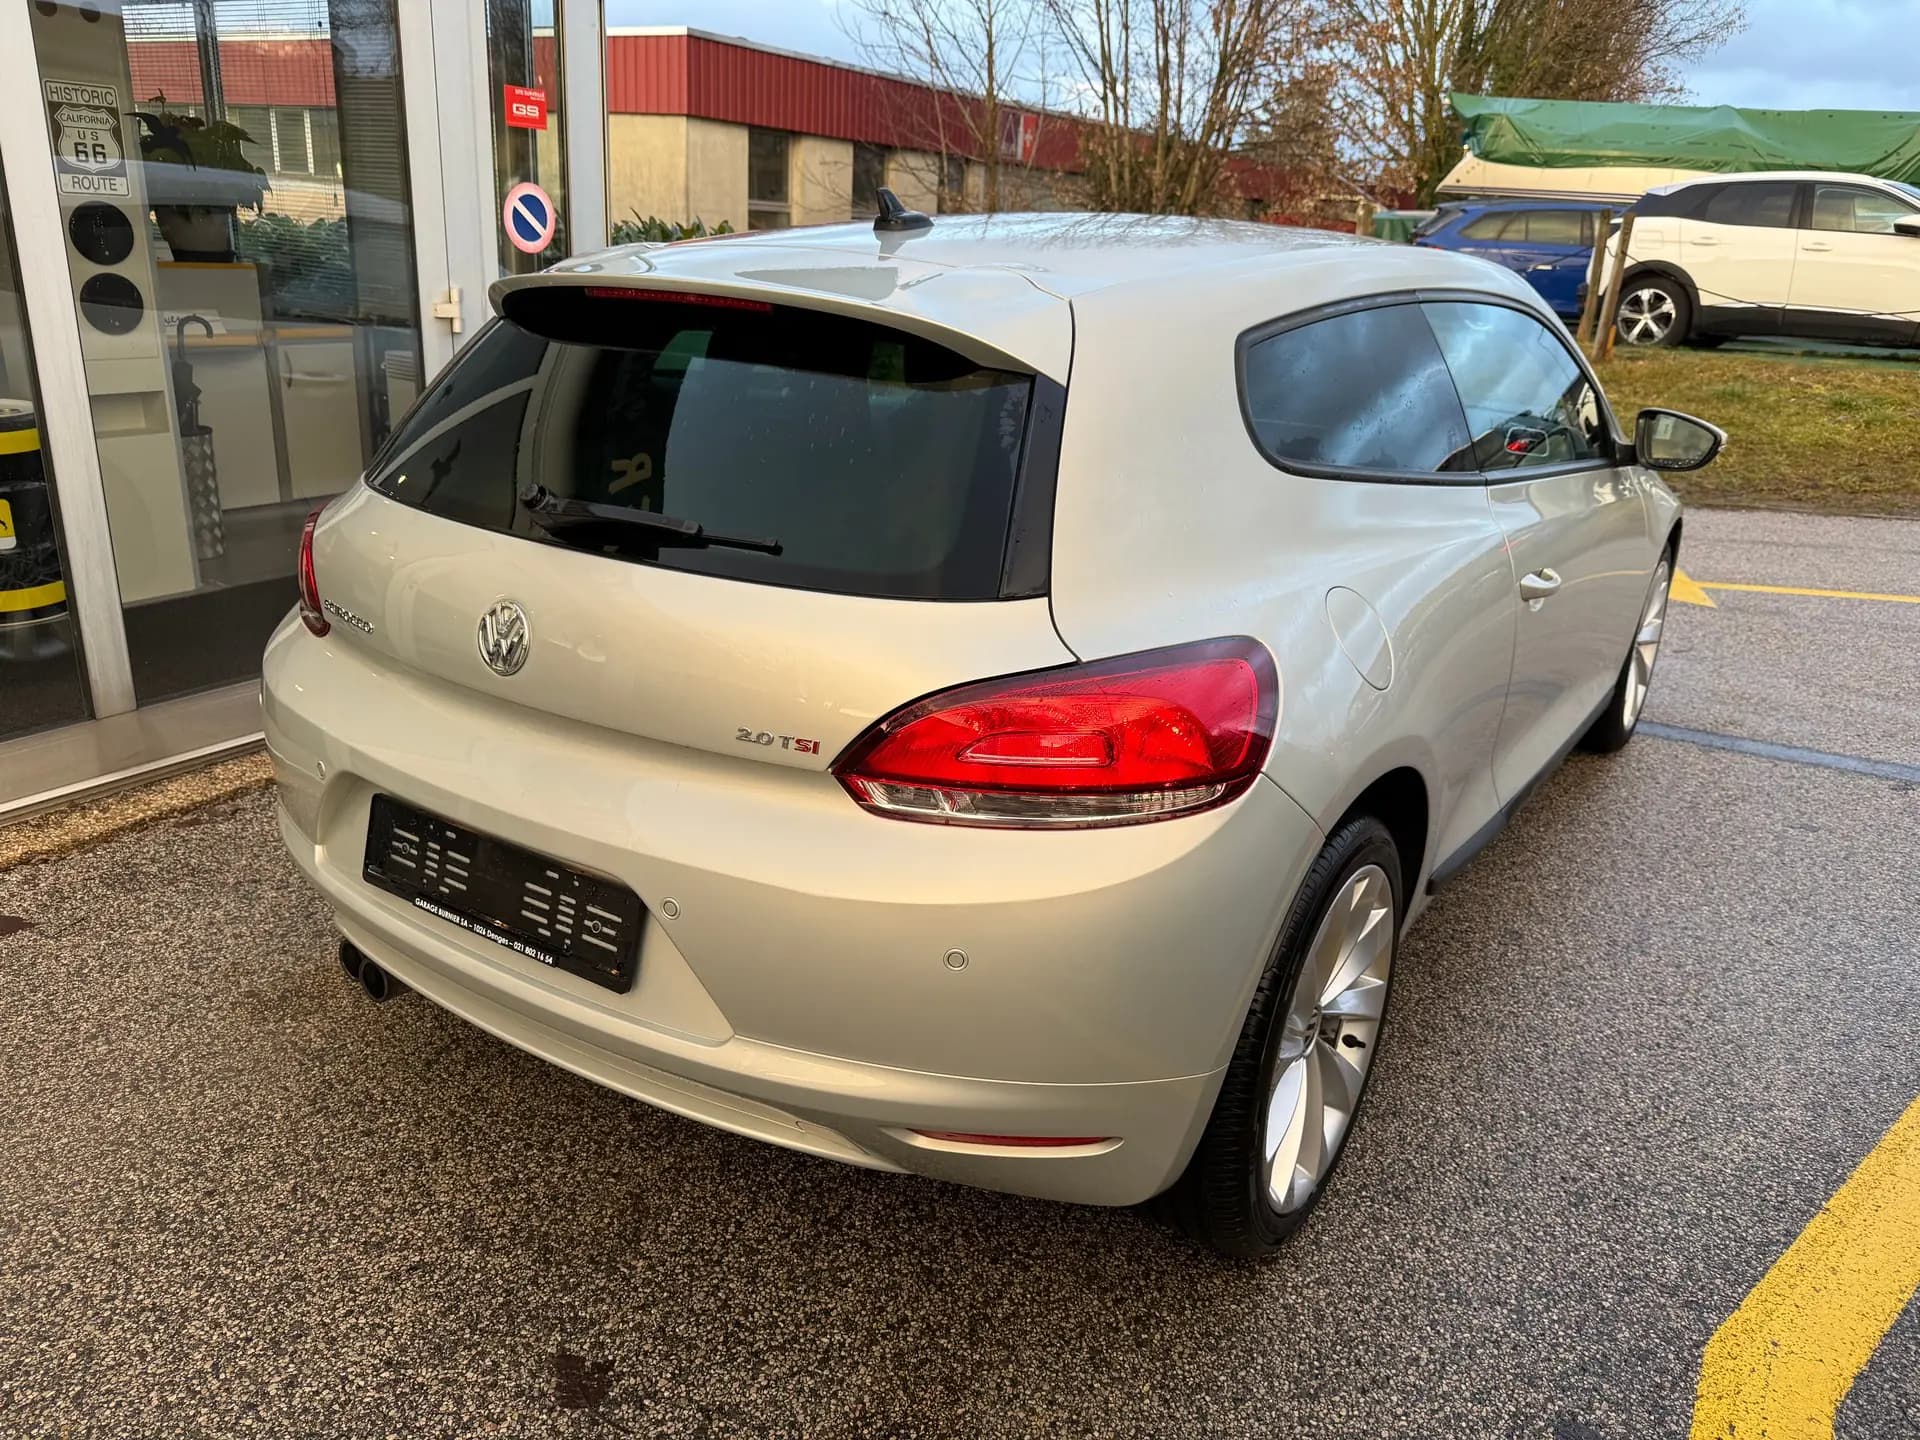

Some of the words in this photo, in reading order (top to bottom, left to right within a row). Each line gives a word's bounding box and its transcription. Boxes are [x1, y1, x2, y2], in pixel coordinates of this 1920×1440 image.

[49, 85, 114, 106] HISTORIC
[60, 112, 111, 126] CALIFORNIA
[74, 142, 107, 164] 66
[72, 175, 118, 192] ROUTE
[778, 734, 821, 755] TSI
[415, 897, 438, 914] GARAGE
[438, 907, 461, 924] BURNIER
[473, 923, 487, 936] 1026
[486, 929, 509, 945] Denges
[513, 941, 525, 953] 021
[524, 946, 537, 958] 802
[537, 951, 545, 961] 16
[544, 954, 554, 965] 54
